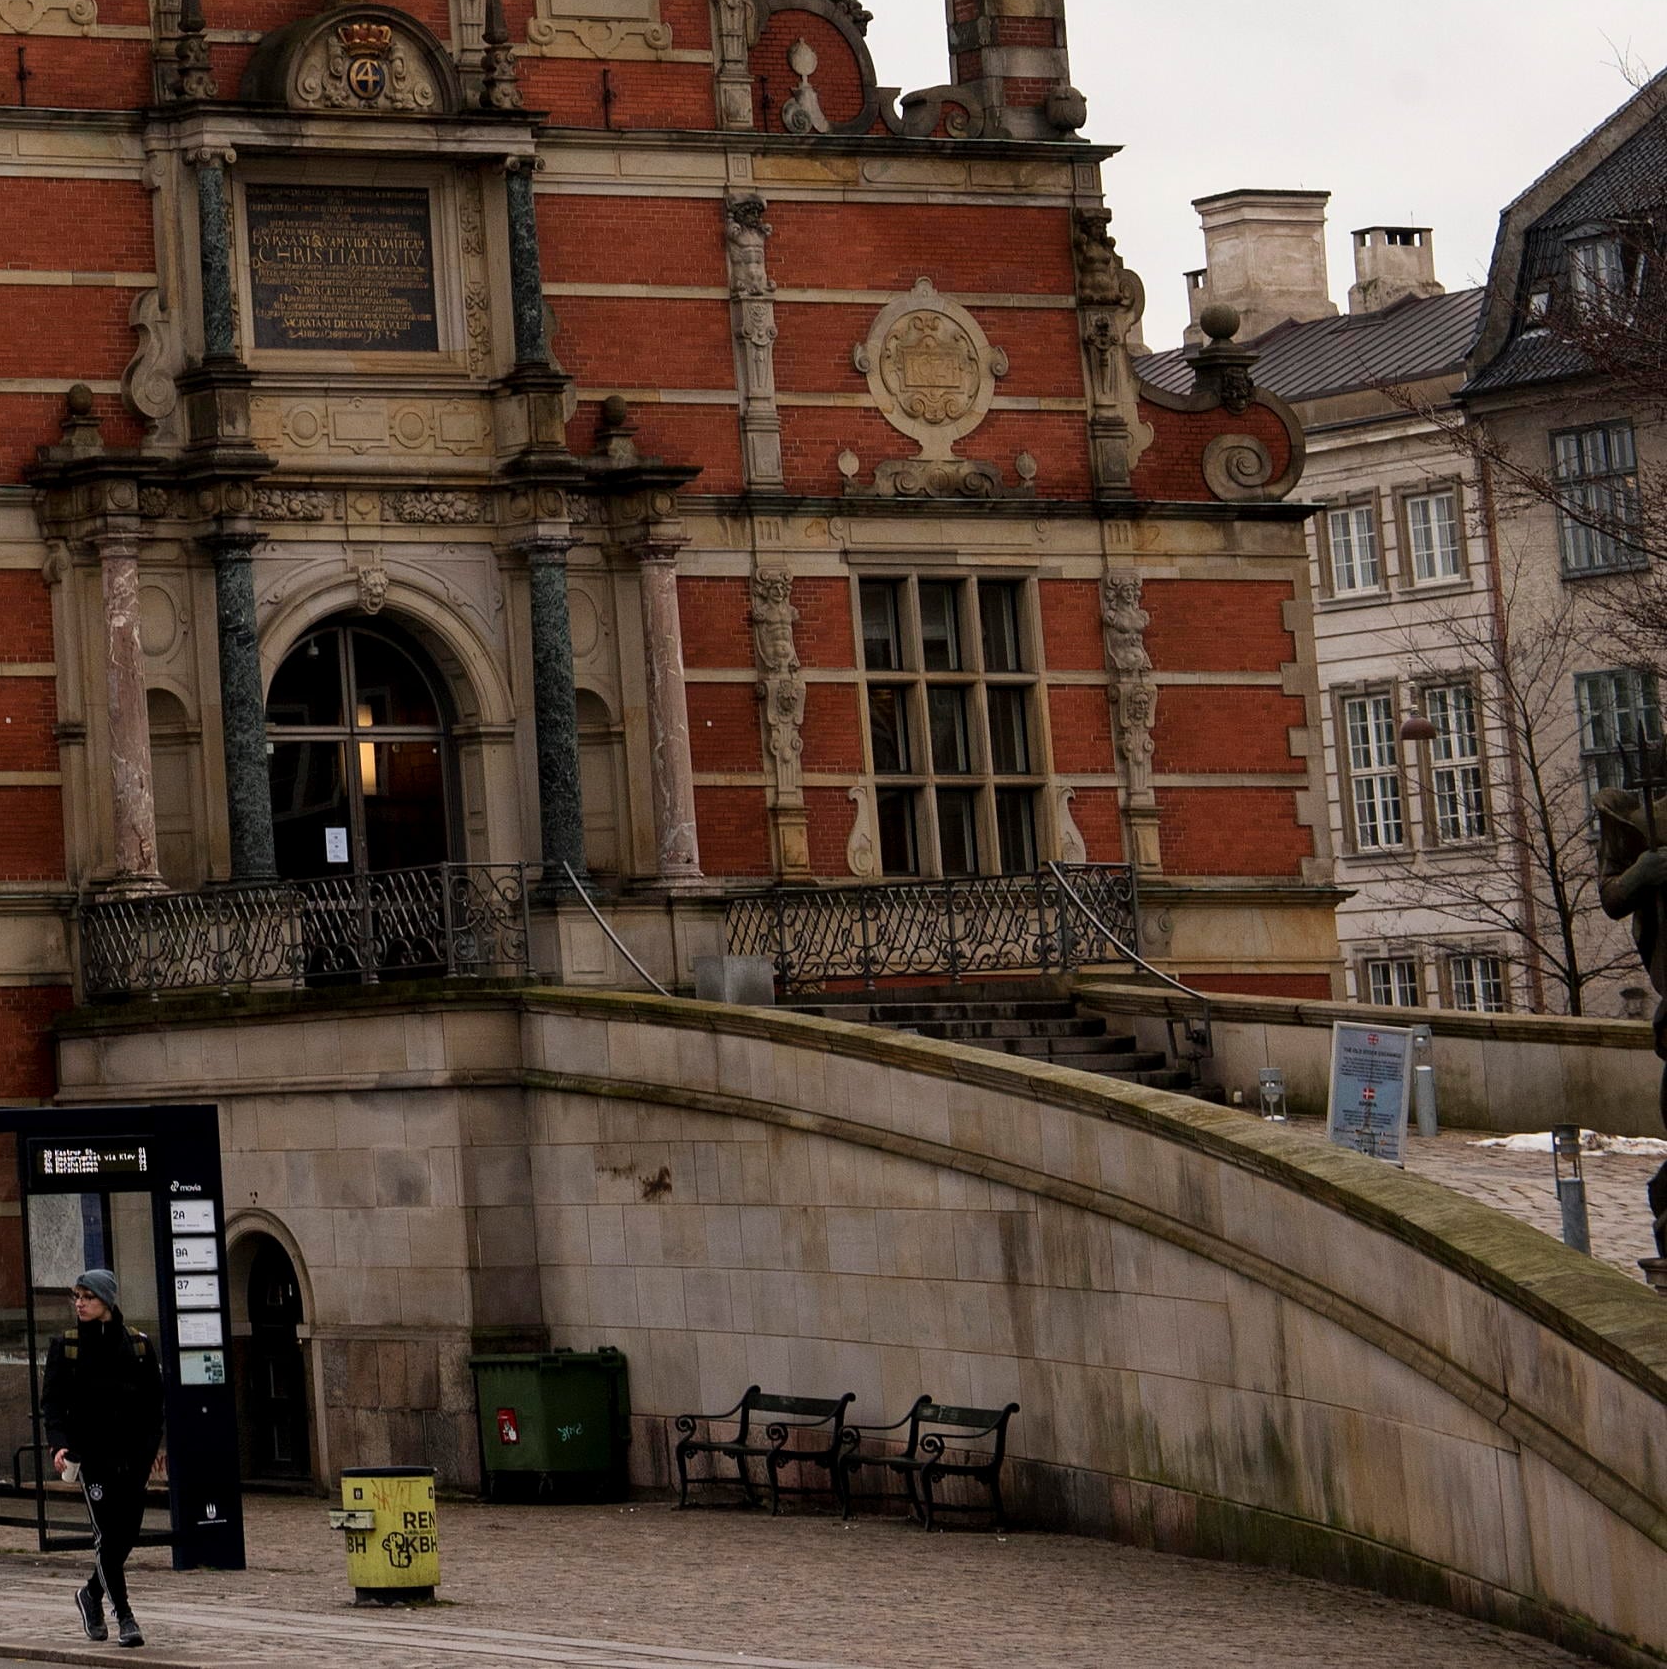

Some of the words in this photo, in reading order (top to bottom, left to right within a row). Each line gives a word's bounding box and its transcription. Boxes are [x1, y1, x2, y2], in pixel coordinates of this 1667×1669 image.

[180, 1183, 202, 1192] movia
[173, 1211, 185, 1220] 2A
[175, 1248, 188, 1258] 9A
[177, 1280, 189, 1290] 37
